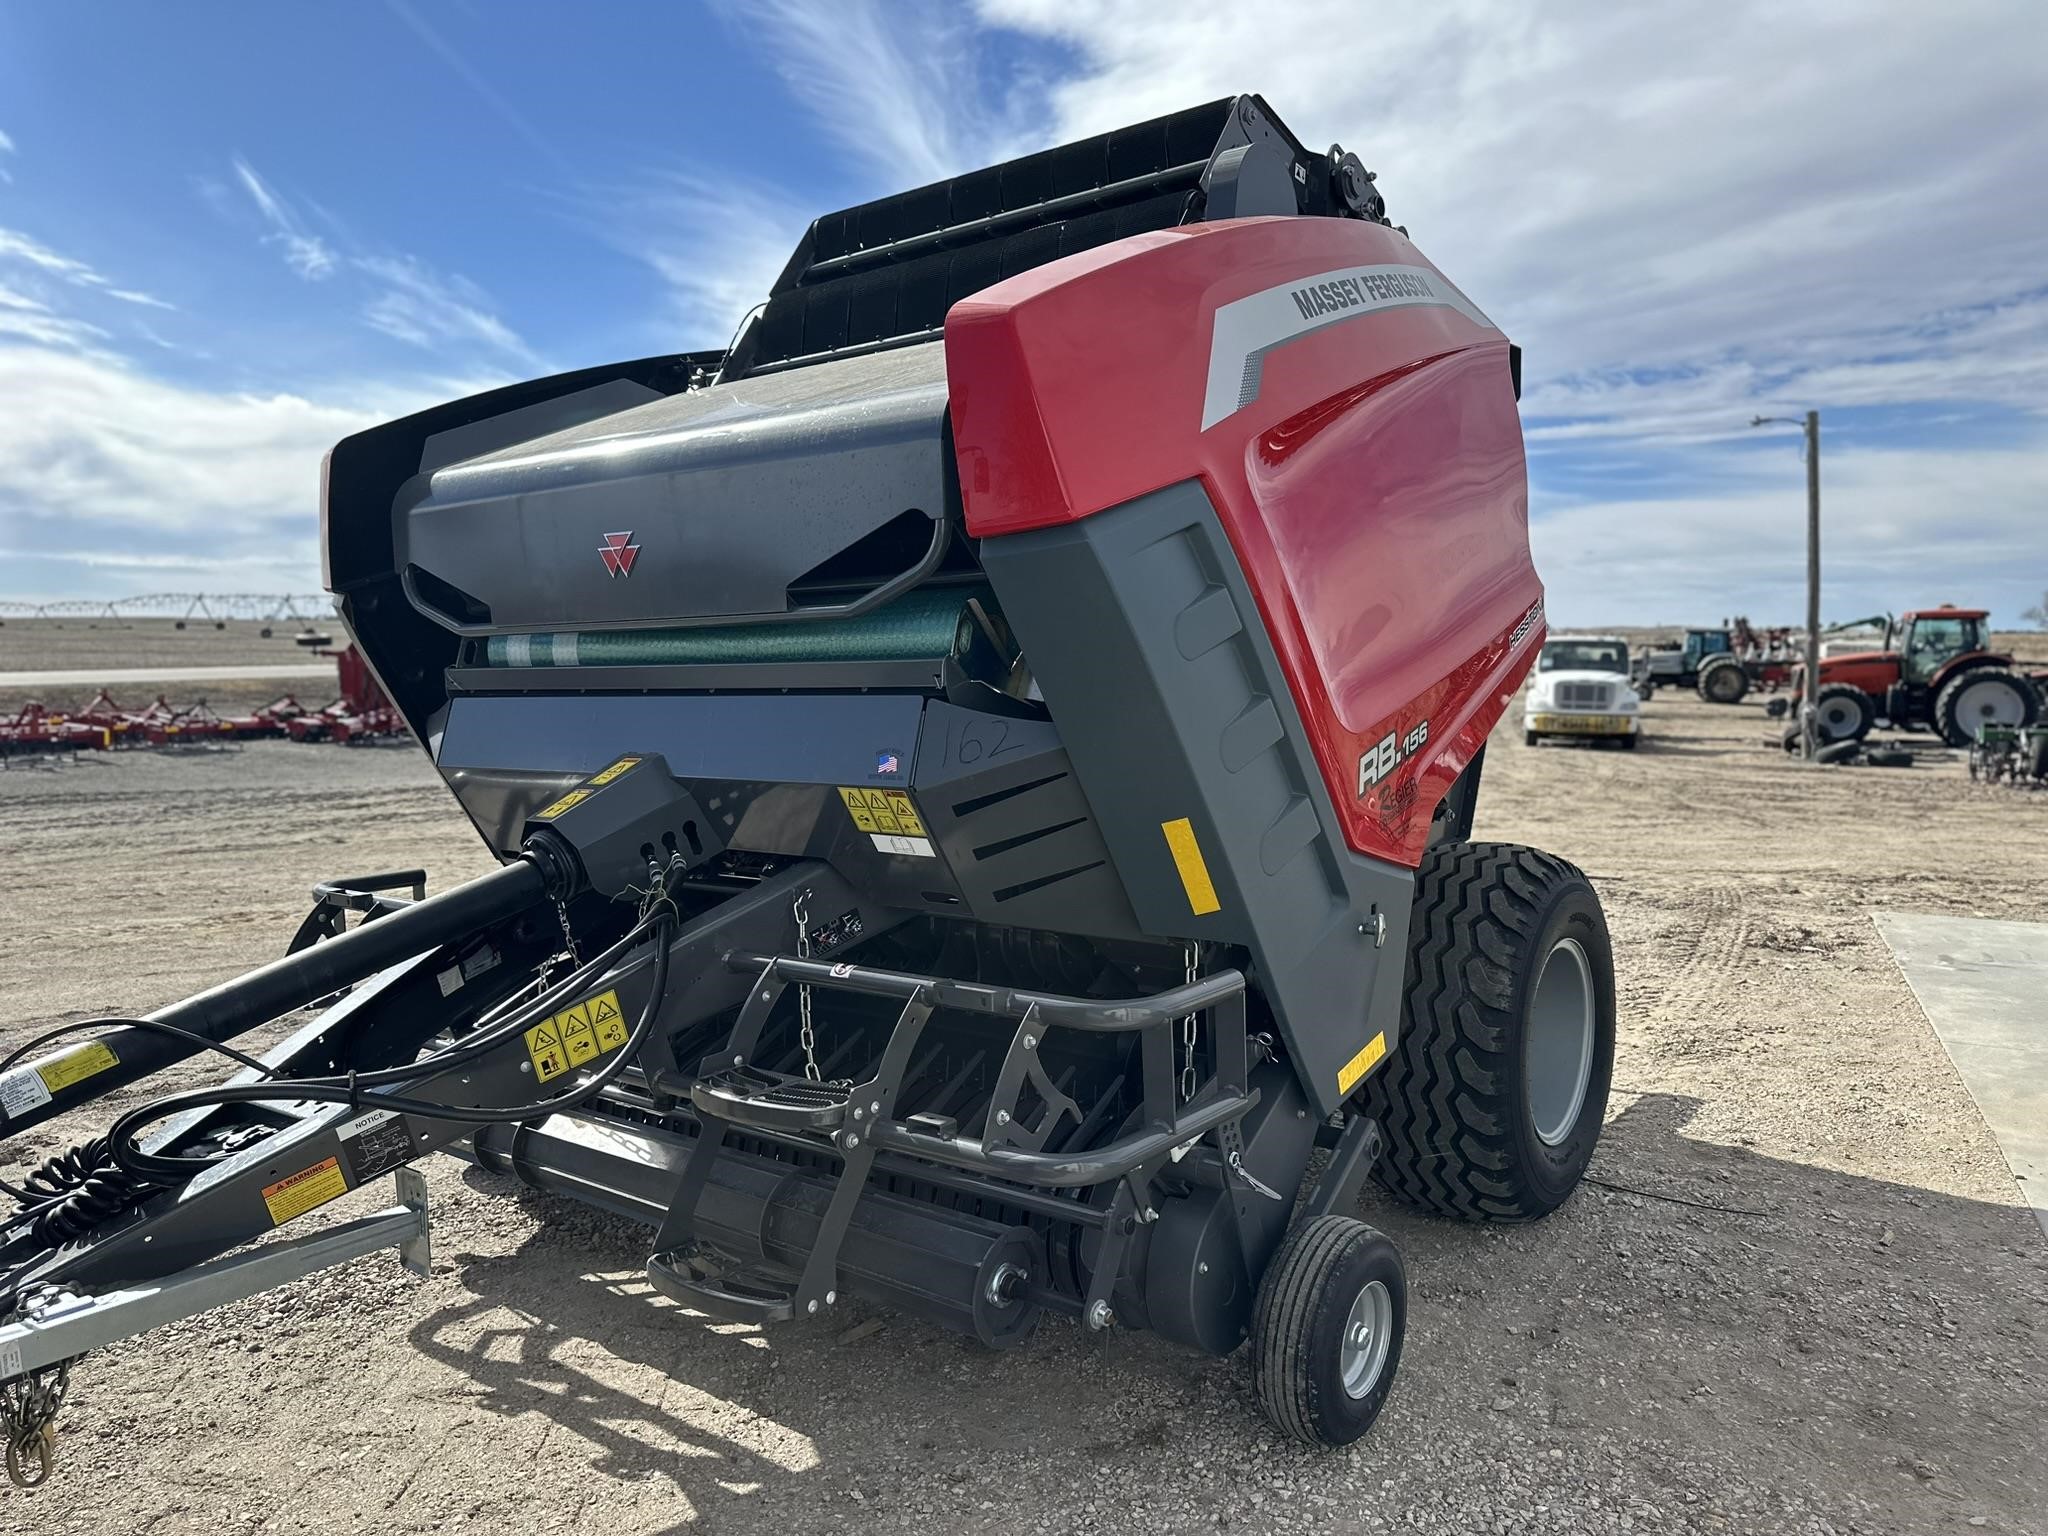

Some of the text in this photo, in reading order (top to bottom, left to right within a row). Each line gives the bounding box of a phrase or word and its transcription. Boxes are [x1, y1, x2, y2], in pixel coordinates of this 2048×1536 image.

[1291, 273, 1434, 320] MASSEY FERGUSON
[1509, 598, 1544, 649] HESSTON
[943, 719, 1025, 768] 162
[355, 1112, 385, 1129] NOTICE
[284, 1163, 325, 1186] WARNING
